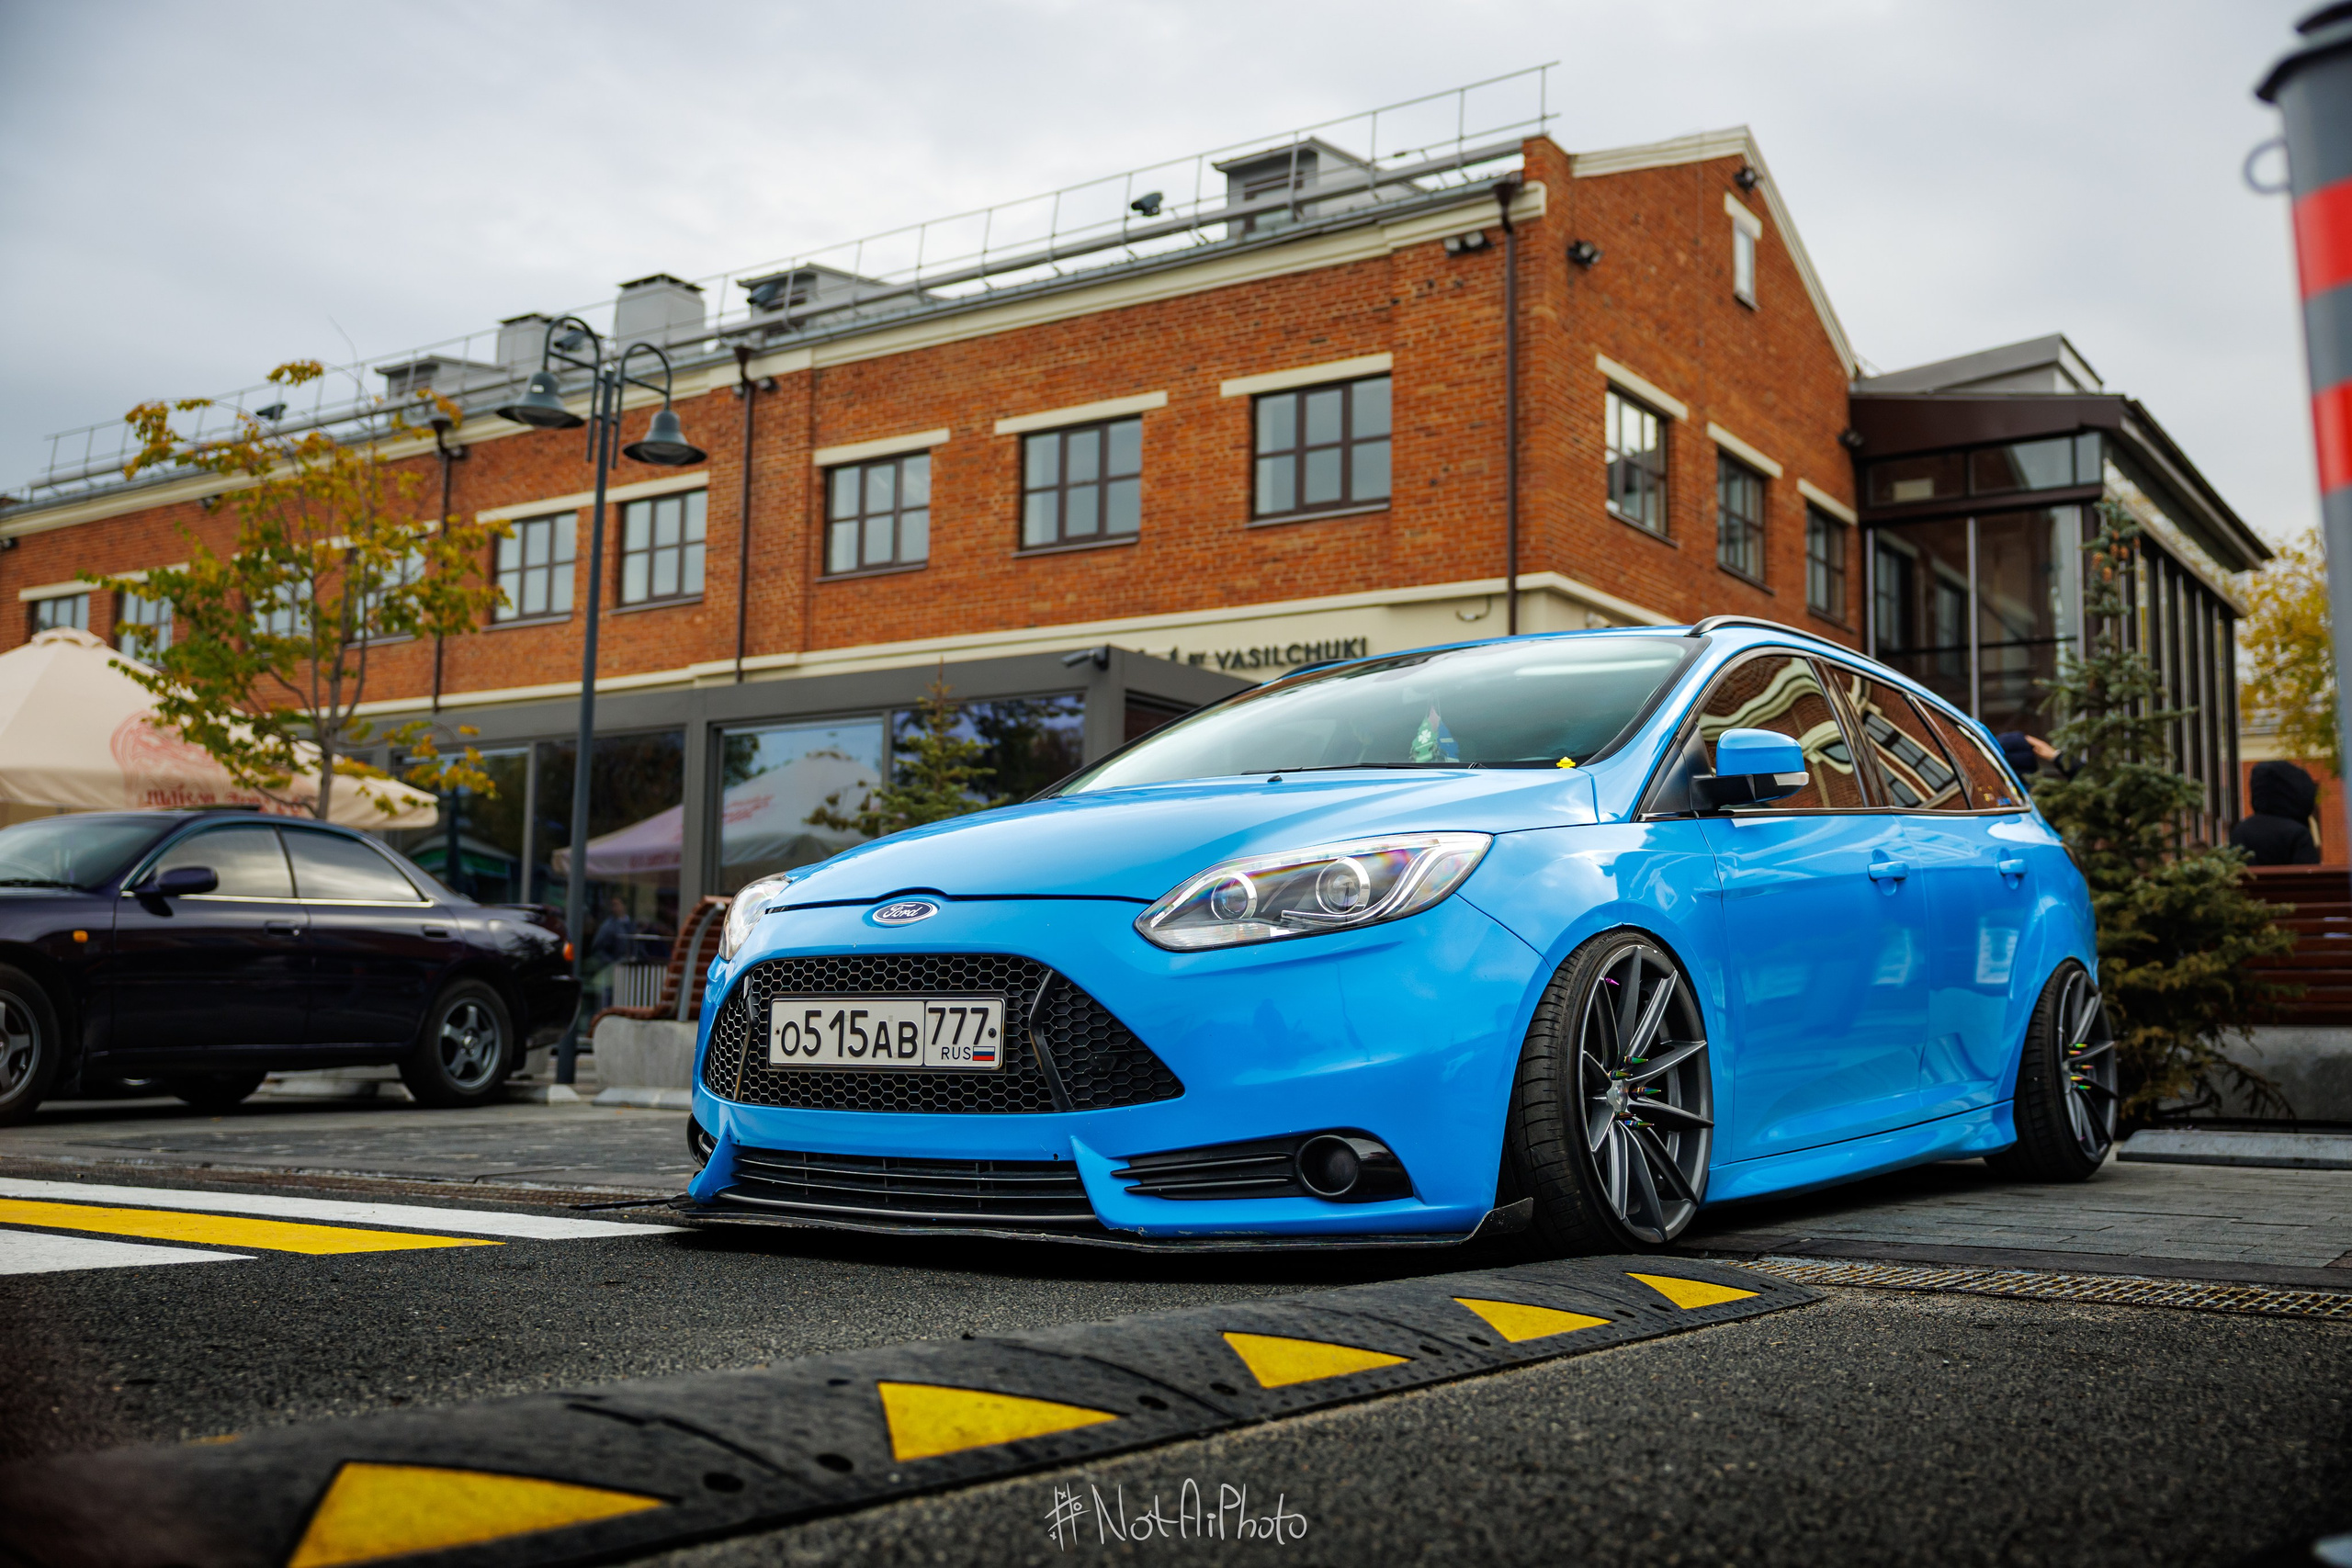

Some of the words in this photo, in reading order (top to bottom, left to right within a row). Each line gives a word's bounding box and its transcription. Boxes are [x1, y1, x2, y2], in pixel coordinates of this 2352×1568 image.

[1216, 637, 1367, 670] VASILCHUKI
[882, 904, 922, 918] Ford
[928, 1007, 989, 1045] 777
[941, 1047, 971, 1060] RUS
